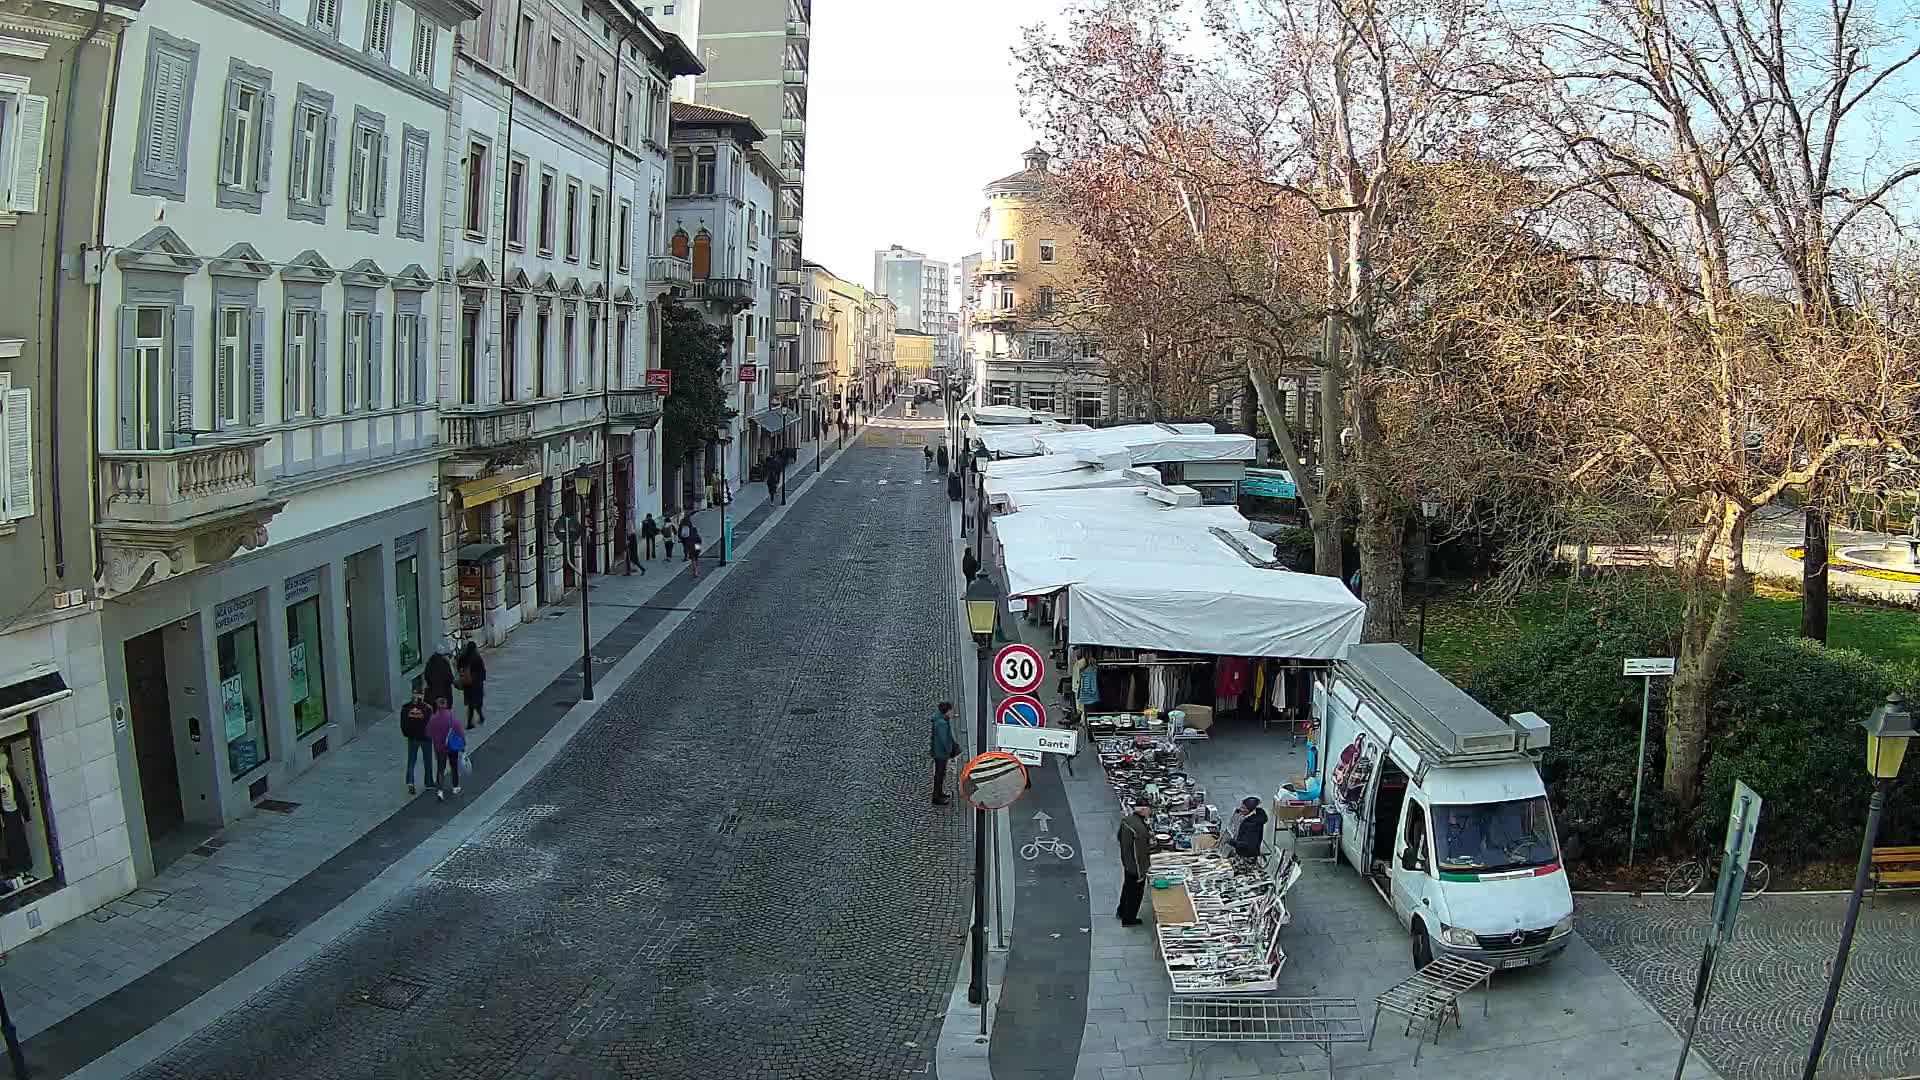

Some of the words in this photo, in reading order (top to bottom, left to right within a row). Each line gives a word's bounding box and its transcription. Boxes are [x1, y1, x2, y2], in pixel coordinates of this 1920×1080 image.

[1005, 658, 1033, 680] 30
[222, 678, 241, 701] 130
[1039, 738, 1070, 749] Dante
